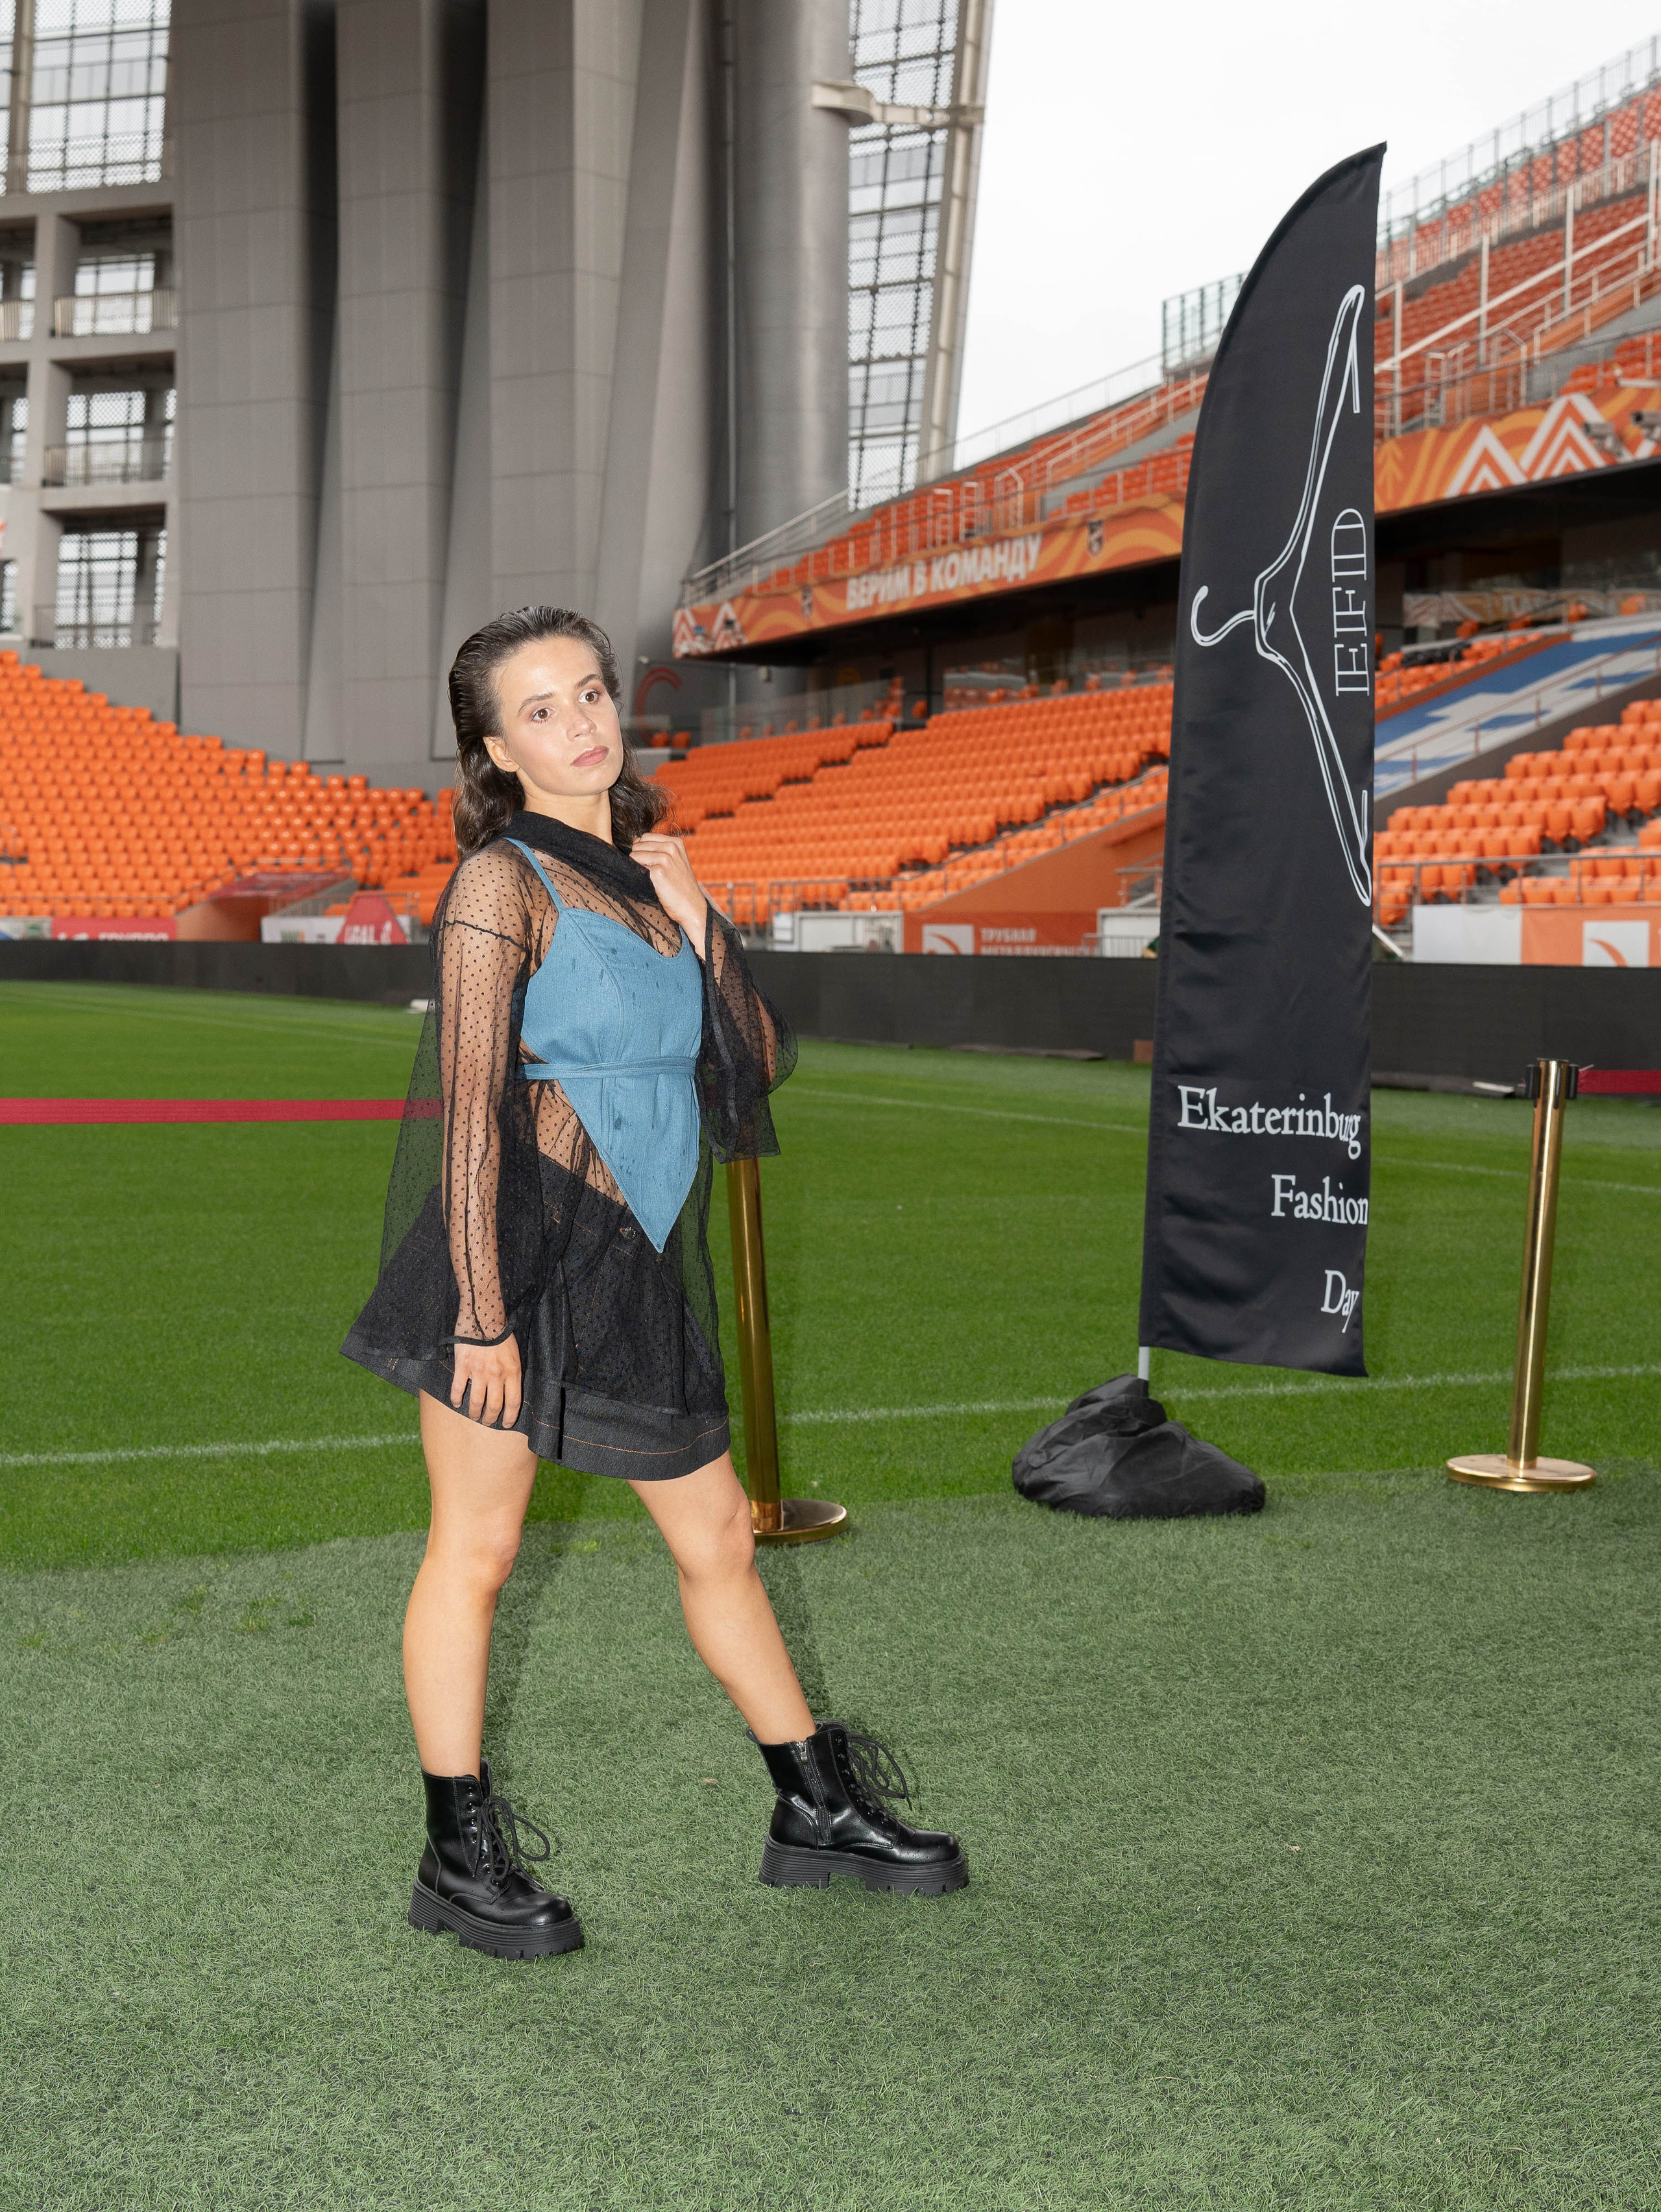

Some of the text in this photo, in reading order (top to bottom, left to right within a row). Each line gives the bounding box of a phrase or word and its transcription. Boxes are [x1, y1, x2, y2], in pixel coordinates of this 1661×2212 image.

[846, 533, 1043, 611] ВЕРИМ В КОМАНДУ
[1331, 508, 1370, 697] EFD
[1177, 1085, 1361, 1160] Ekaterinburg
[1270, 1174, 1368, 1225] Fashion
[1320, 1269, 1360, 1334] Day
